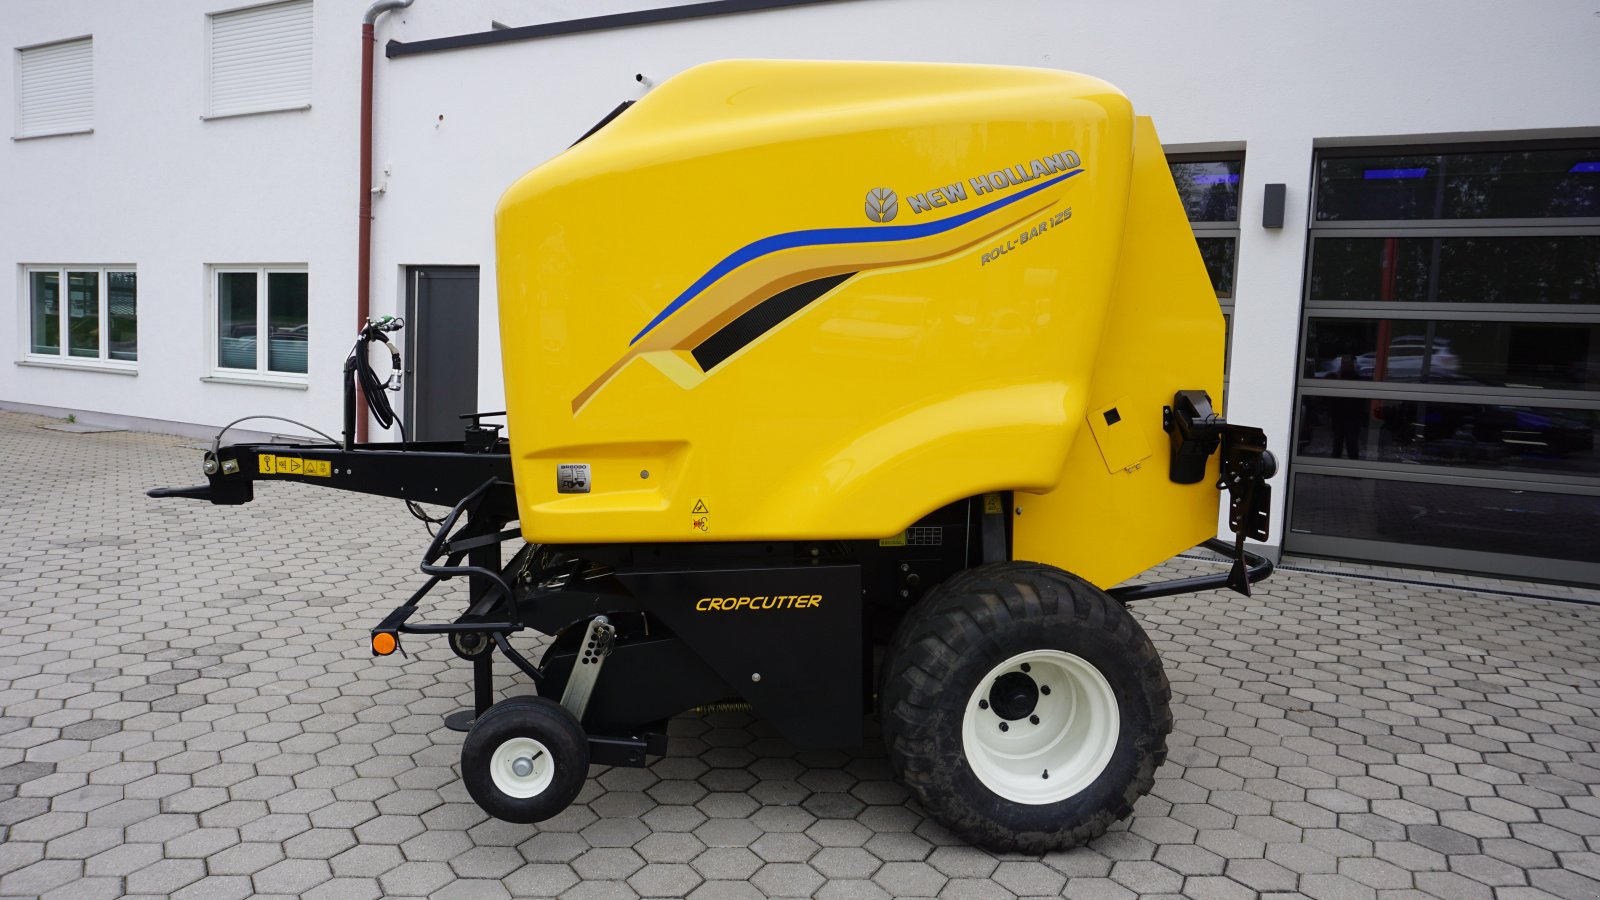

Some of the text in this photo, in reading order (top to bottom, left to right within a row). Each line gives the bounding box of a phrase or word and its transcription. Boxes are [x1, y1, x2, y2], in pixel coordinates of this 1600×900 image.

[906, 150, 1081, 214] NEW HOLLAND
[981, 207, 1072, 266] ROLL-BAR 125
[696, 594, 823, 611] CROPCUTTER
